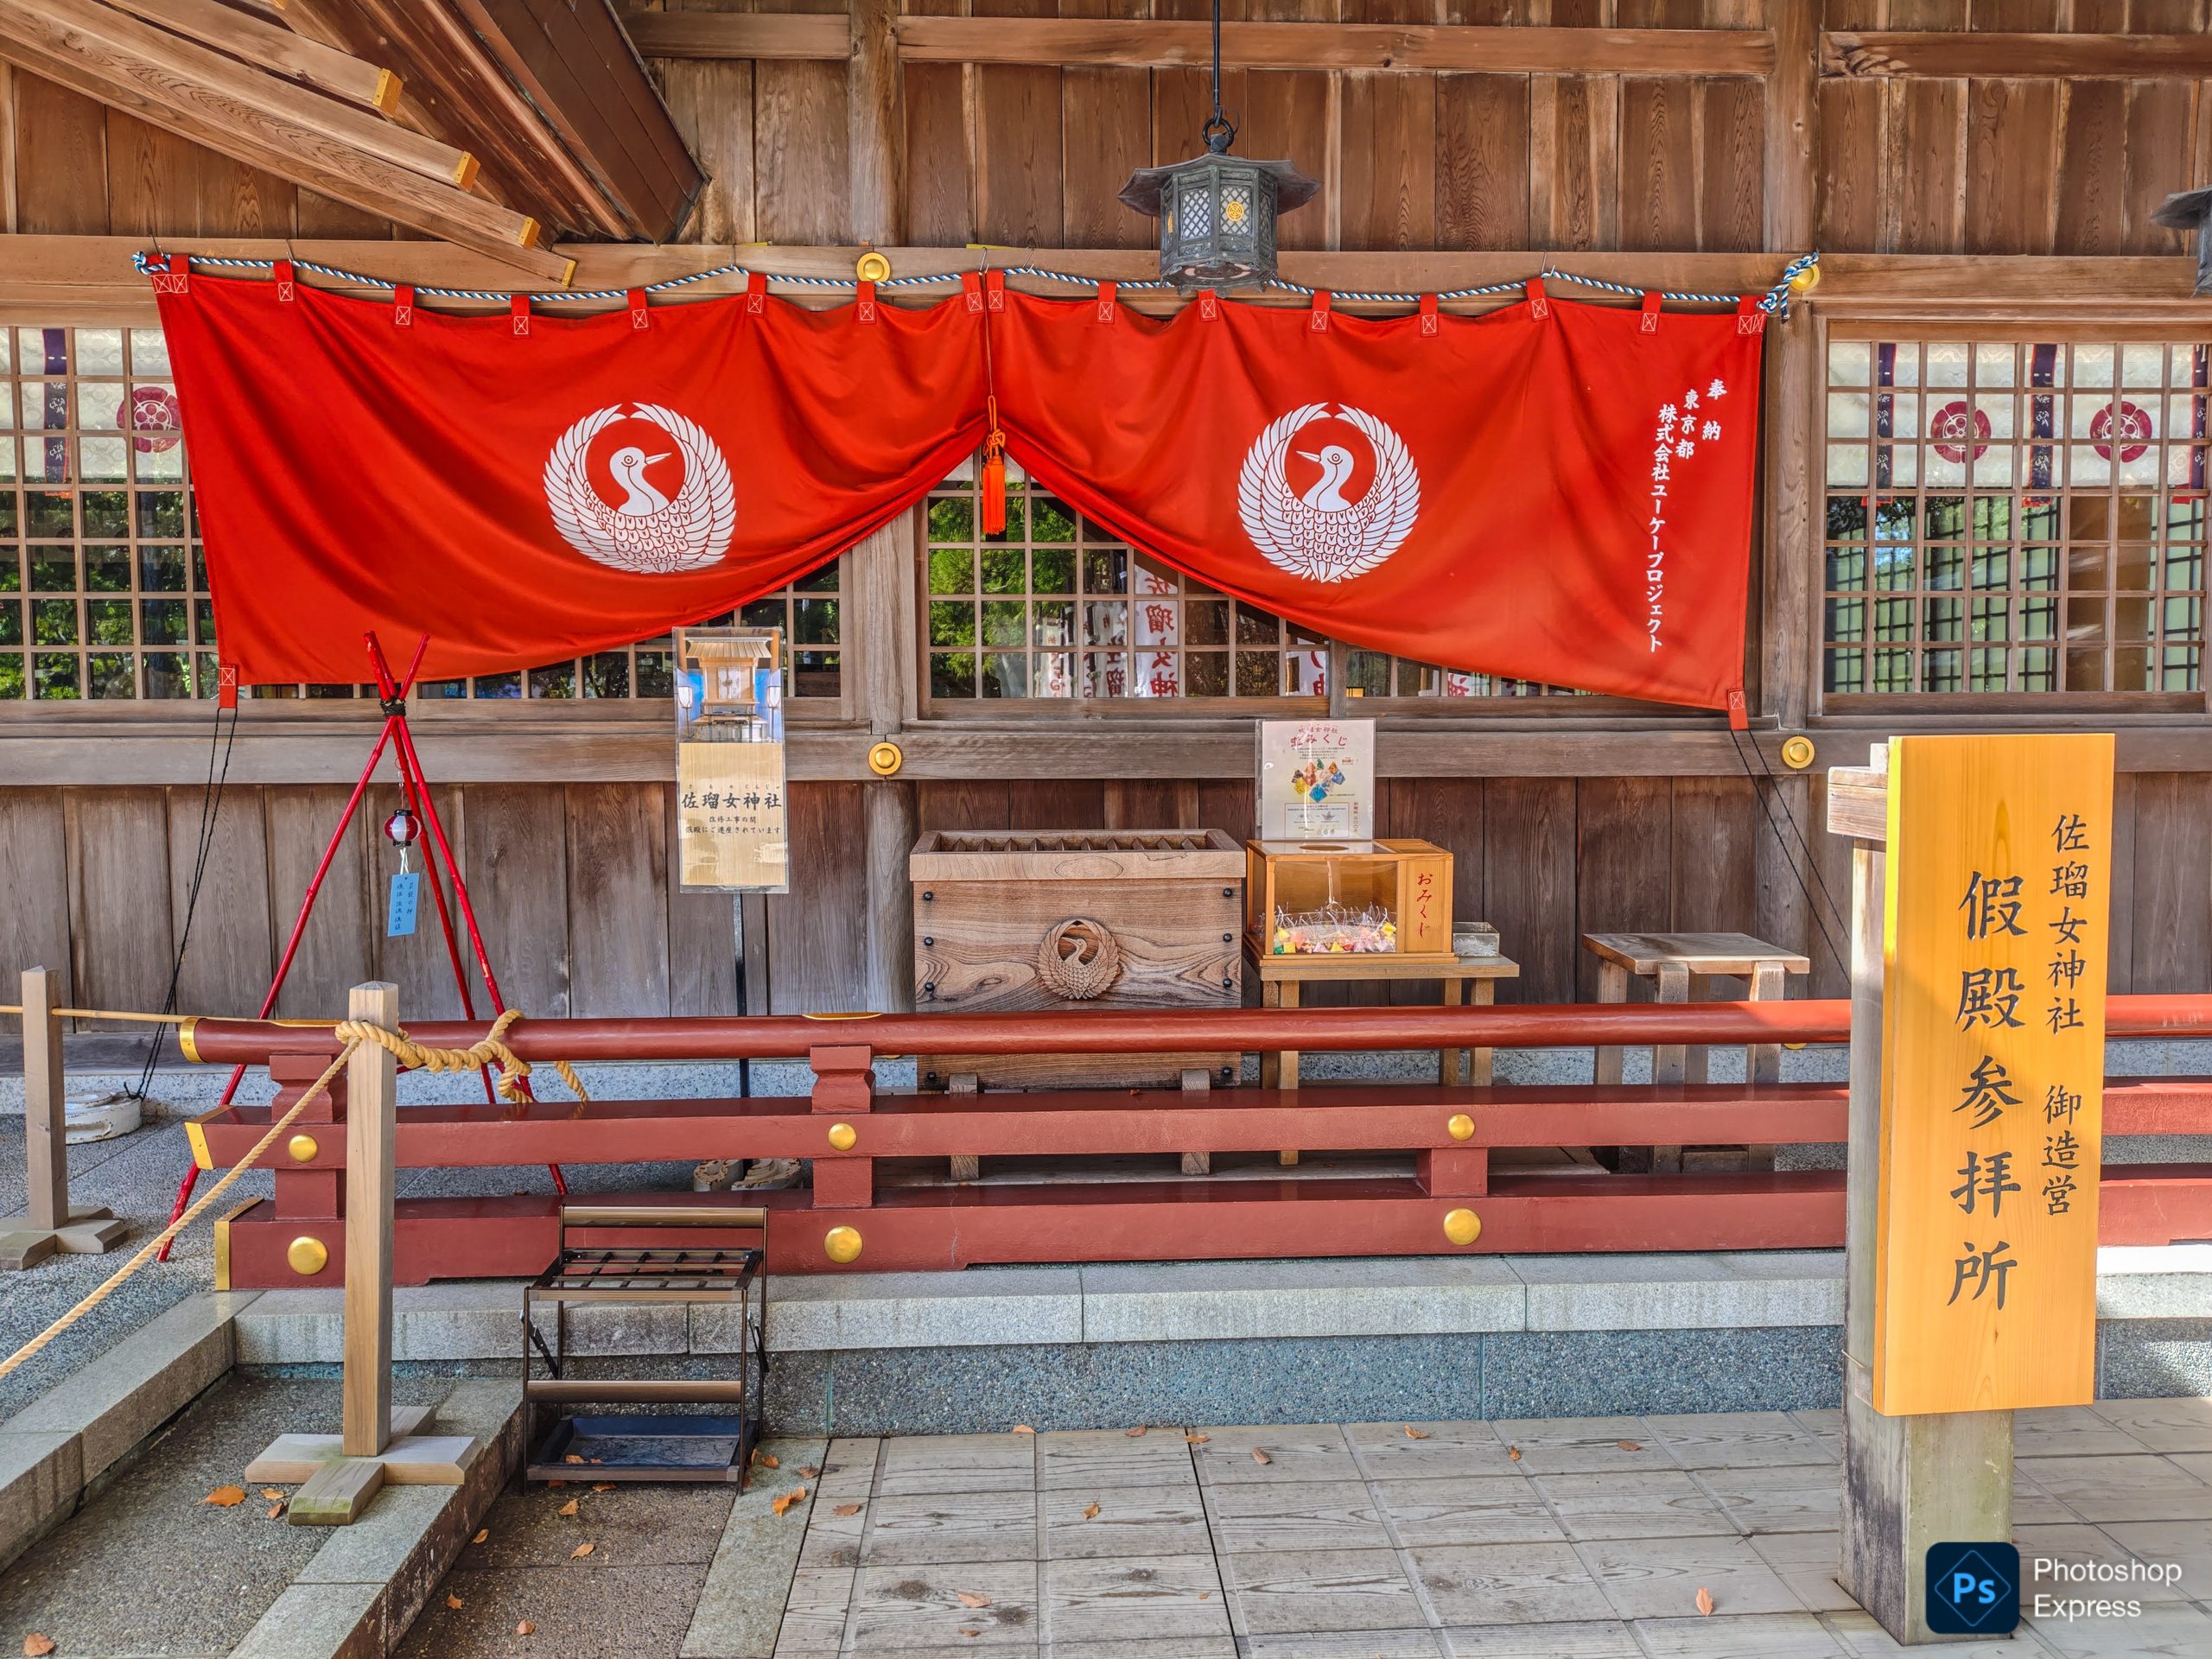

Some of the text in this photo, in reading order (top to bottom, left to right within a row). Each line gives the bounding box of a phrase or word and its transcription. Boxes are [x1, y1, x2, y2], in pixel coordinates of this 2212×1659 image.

[1675, 389, 1700, 460] 東京都
[1701, 378, 1728, 442] 奉納
[1645, 404, 1679, 653] 株式会社ユーケープロジェクト
[681, 791, 782, 811] 佐瑠女神社
[1416, 873, 1433, 938] おみくじ
[2041, 814, 2090, 1217] 佐瑠女神社 御造営
[1946, 869, 2029, 1311] 假殿参拝所
